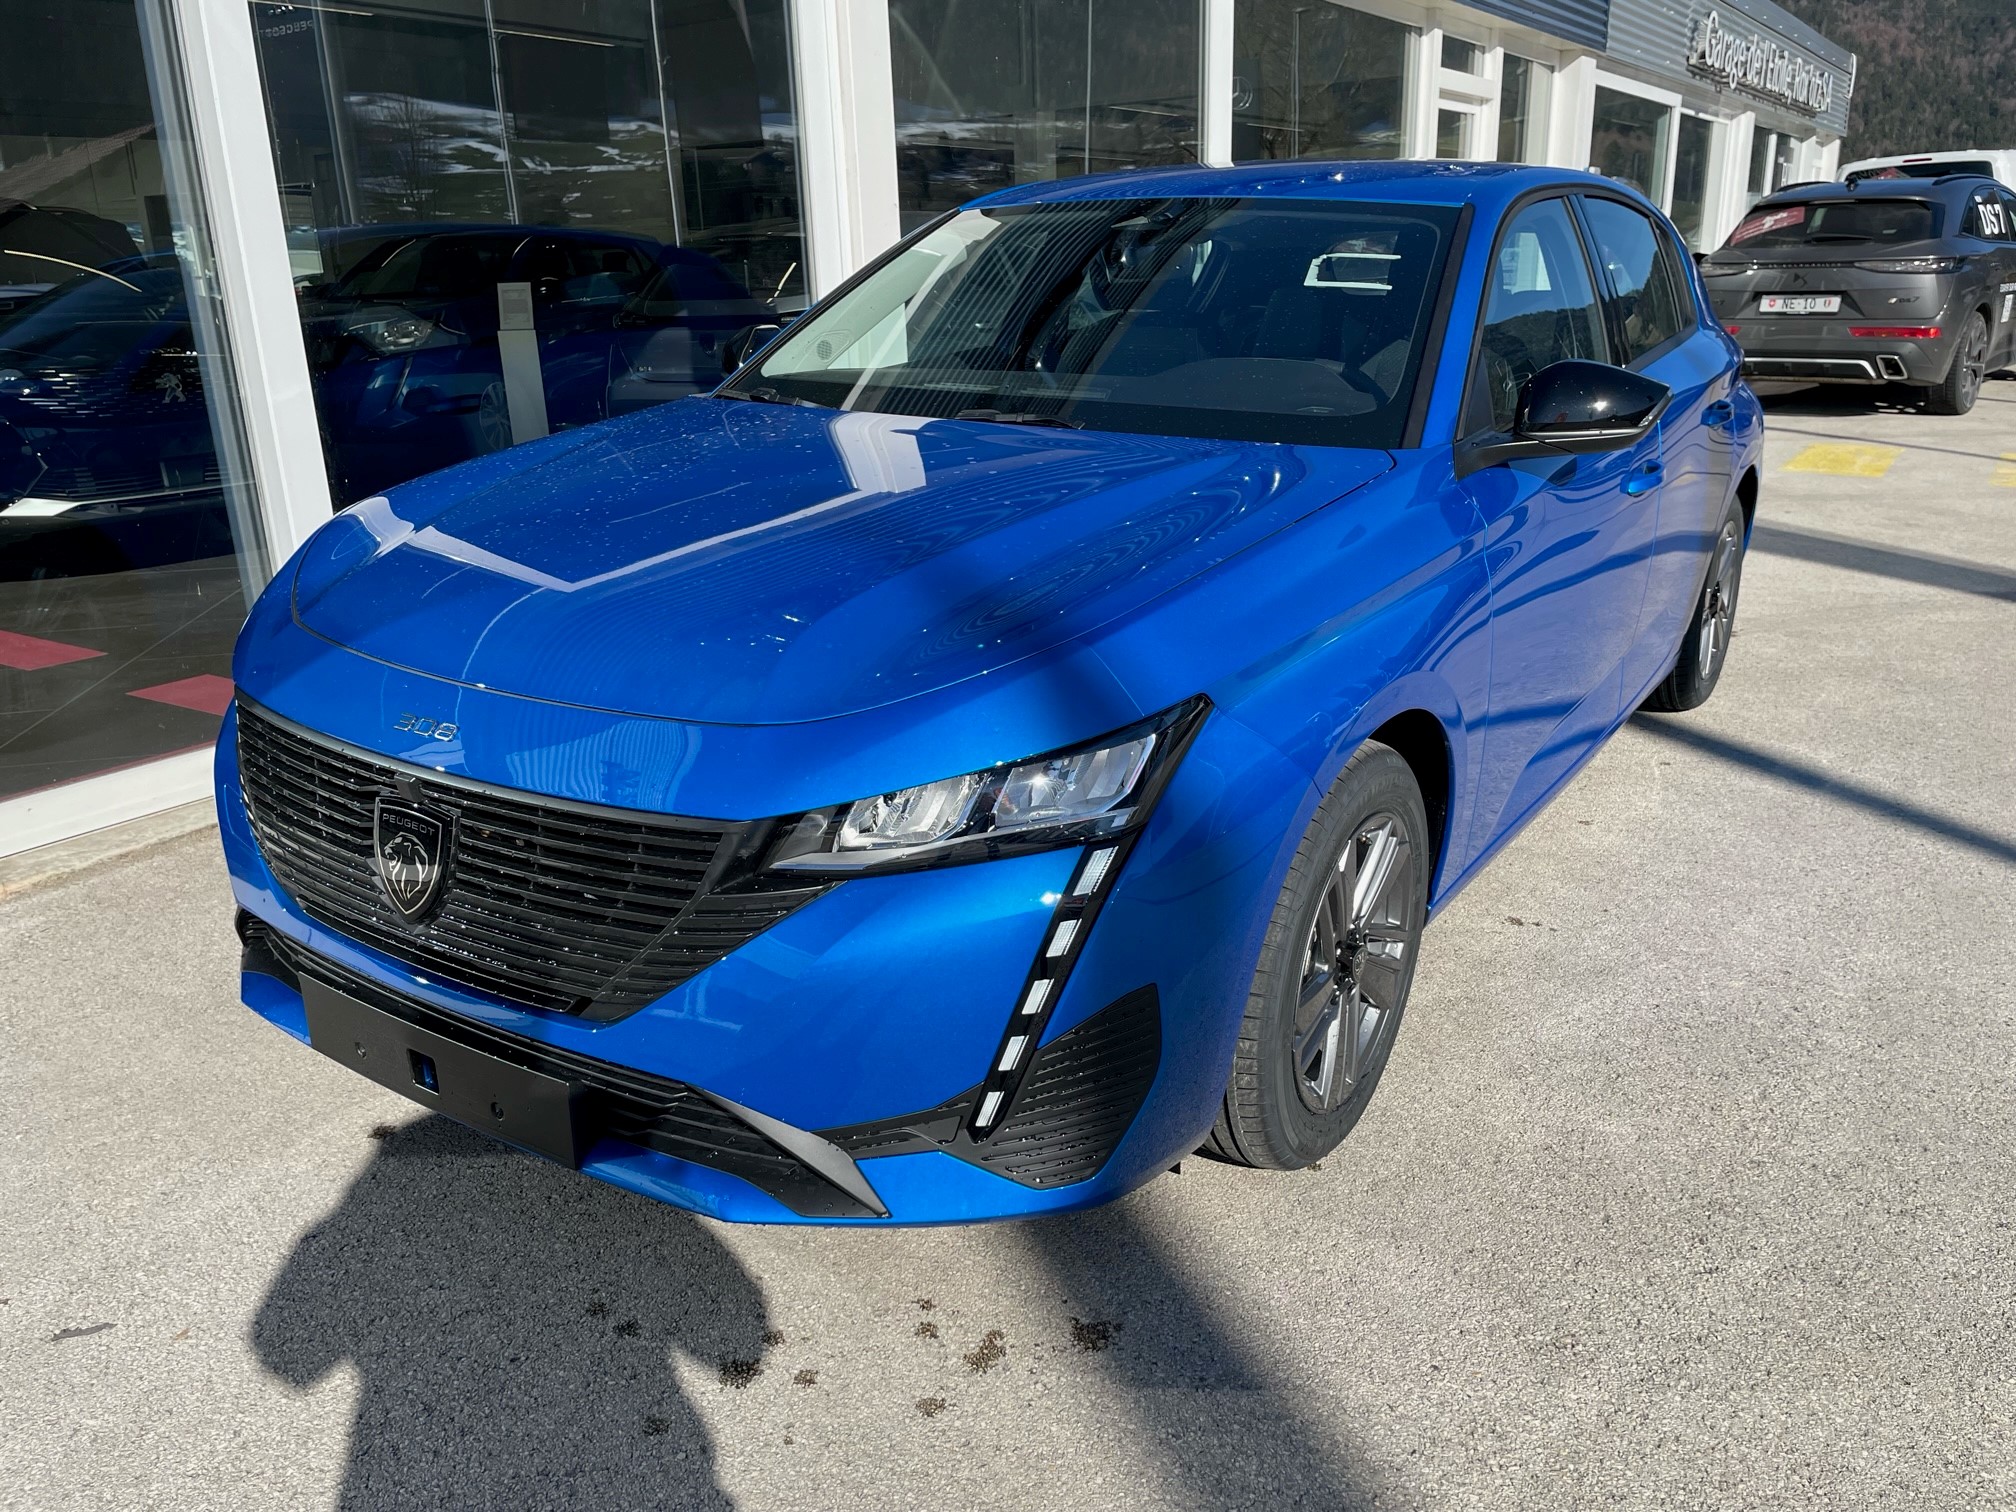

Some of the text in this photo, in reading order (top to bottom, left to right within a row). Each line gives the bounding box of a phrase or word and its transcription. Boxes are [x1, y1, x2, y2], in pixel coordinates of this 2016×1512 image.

[1705, 10, 1746, 90] Garage
[1746, 33, 1760, 85] de
[1781, 297, 1795, 310] NE
[393, 711, 460, 742] 308
[382, 813, 435, 837] PEUGEOT
